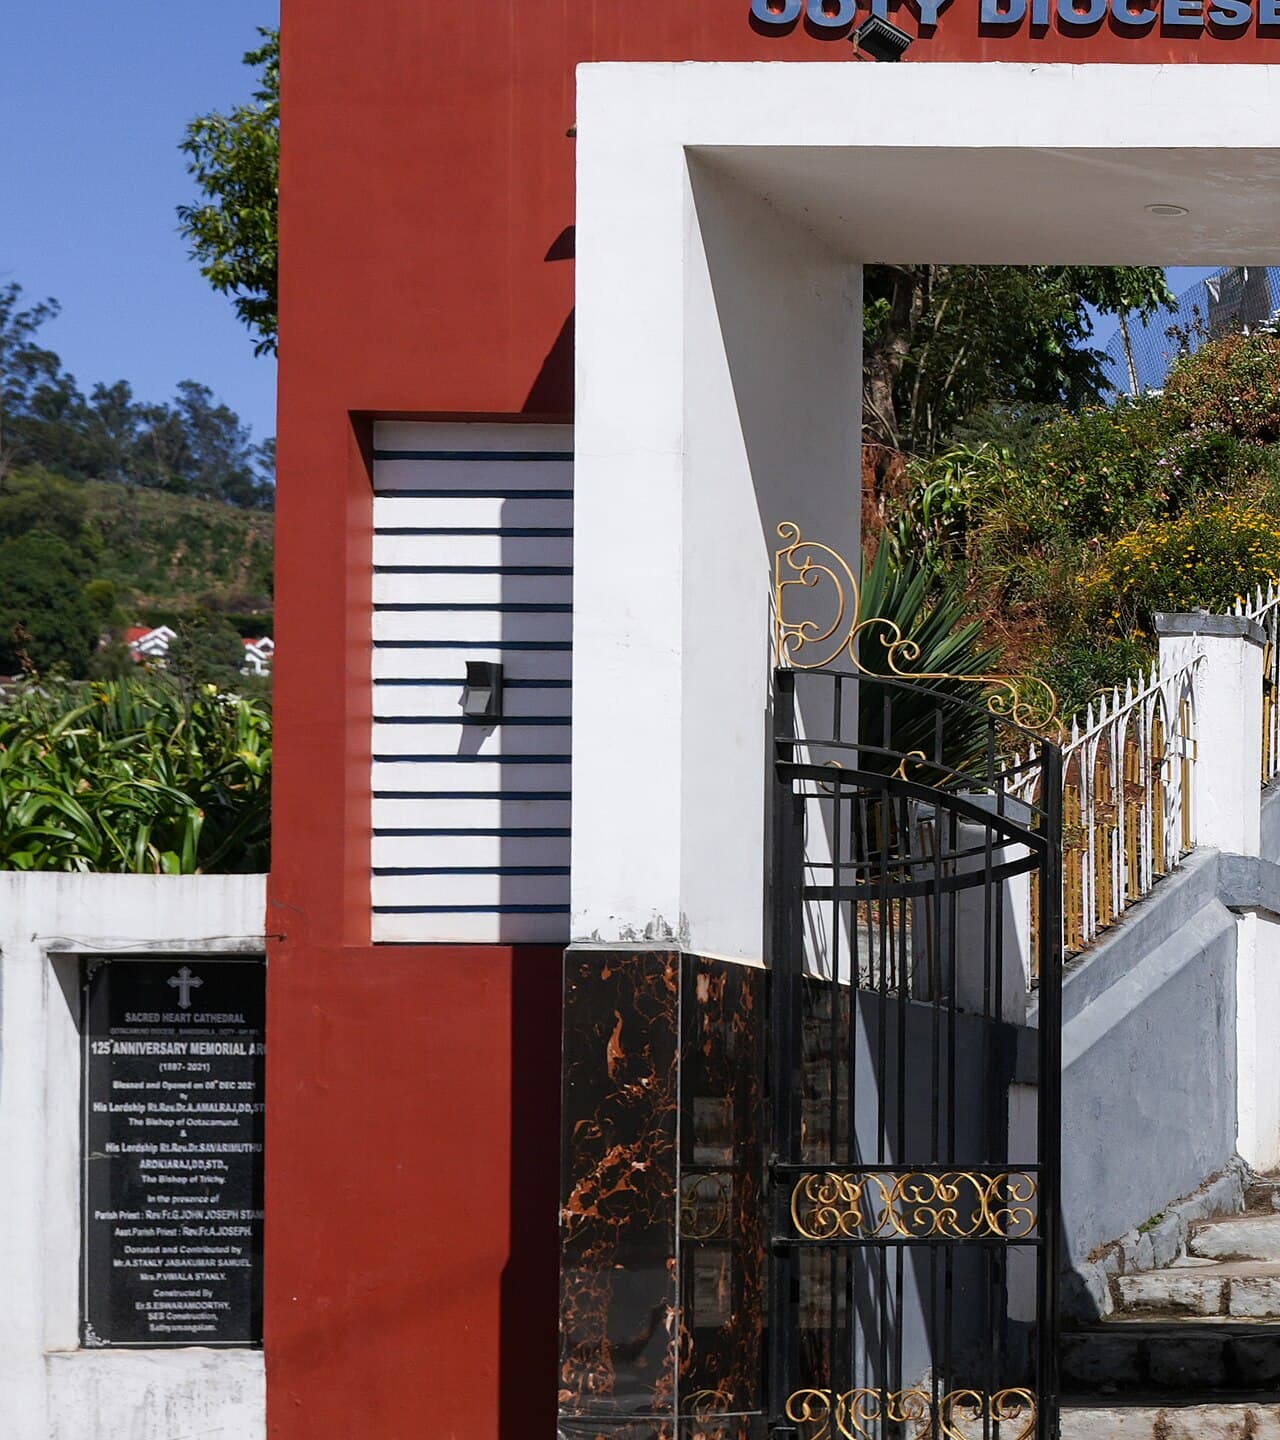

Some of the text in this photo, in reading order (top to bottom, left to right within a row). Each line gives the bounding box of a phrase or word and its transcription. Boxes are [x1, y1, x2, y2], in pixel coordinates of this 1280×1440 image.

[125, 1013, 245, 1023] SACRED HEART CATHEDRAL
[112, 1041, 188, 1055] ANNIVERSARY
[190, 1042, 246, 1055] MEMORIAL
